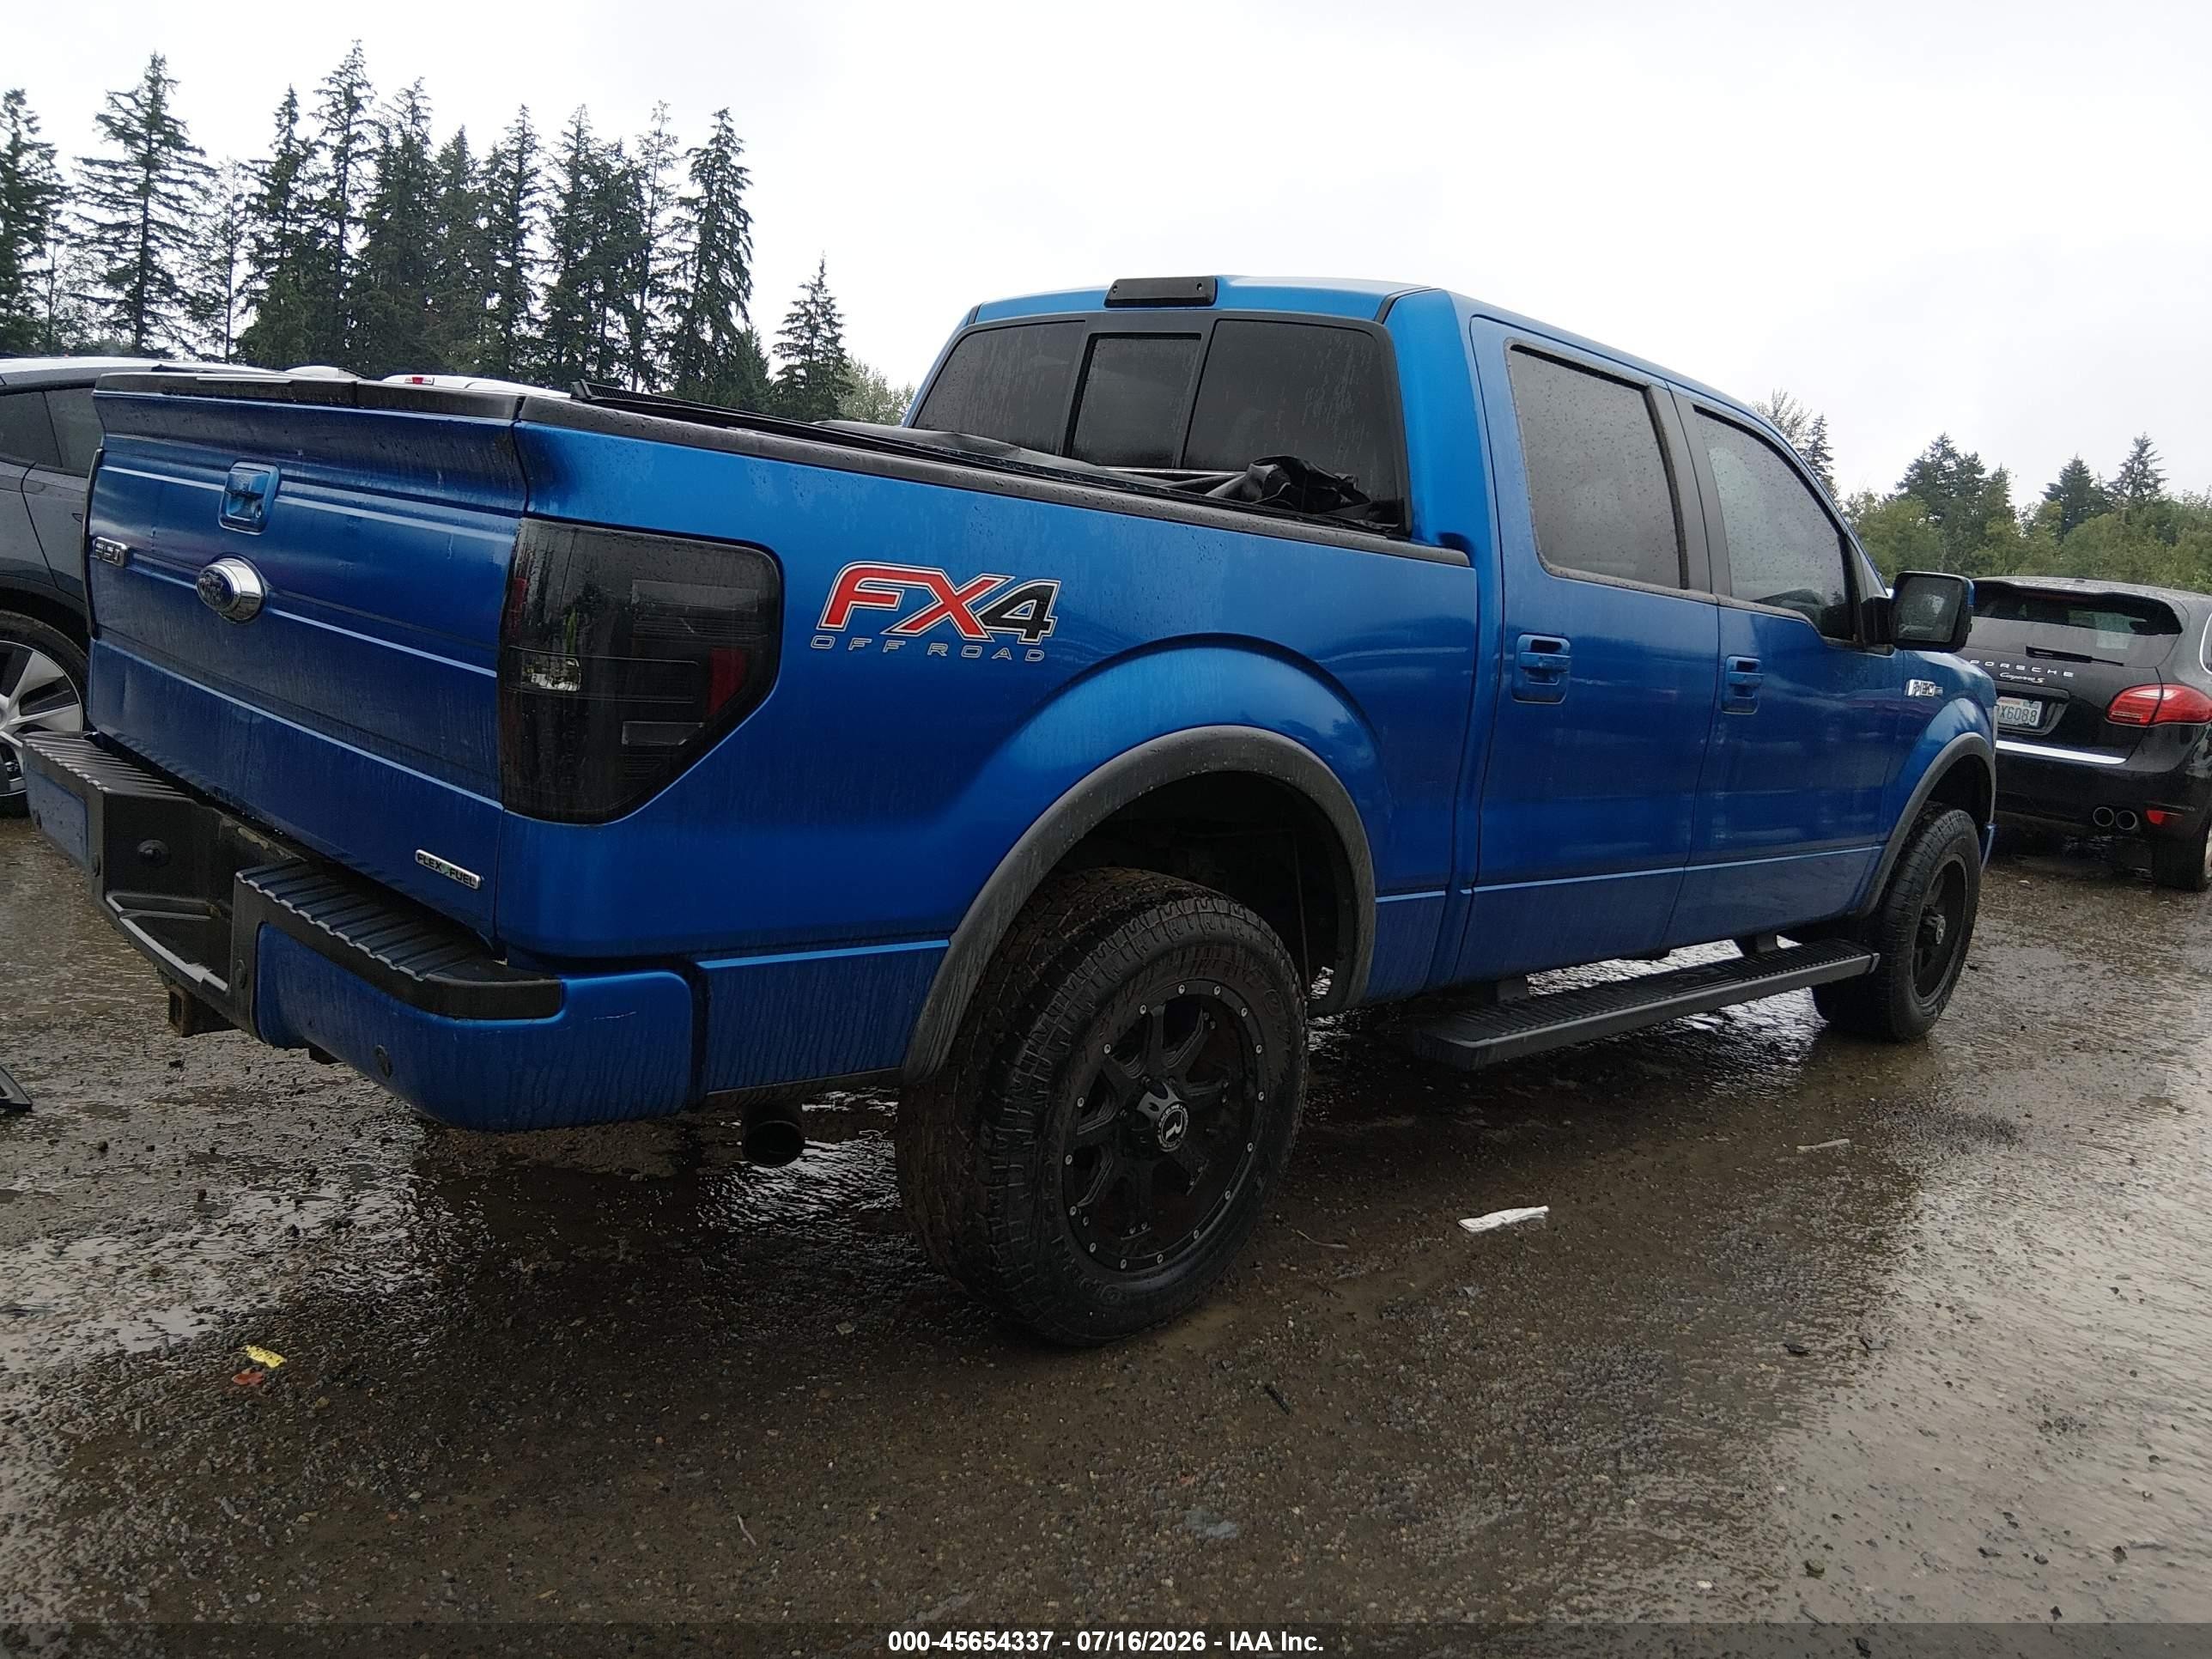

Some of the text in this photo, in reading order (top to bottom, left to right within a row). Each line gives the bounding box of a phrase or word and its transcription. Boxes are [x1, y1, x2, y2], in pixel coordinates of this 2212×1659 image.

[816, 561, 1061, 645] FX4
[811, 635, 1045, 661] OFF ROAD
[1970, 659, 2075, 678] PORSCHE
[417, 853, 475, 887] FLEX FUEL
